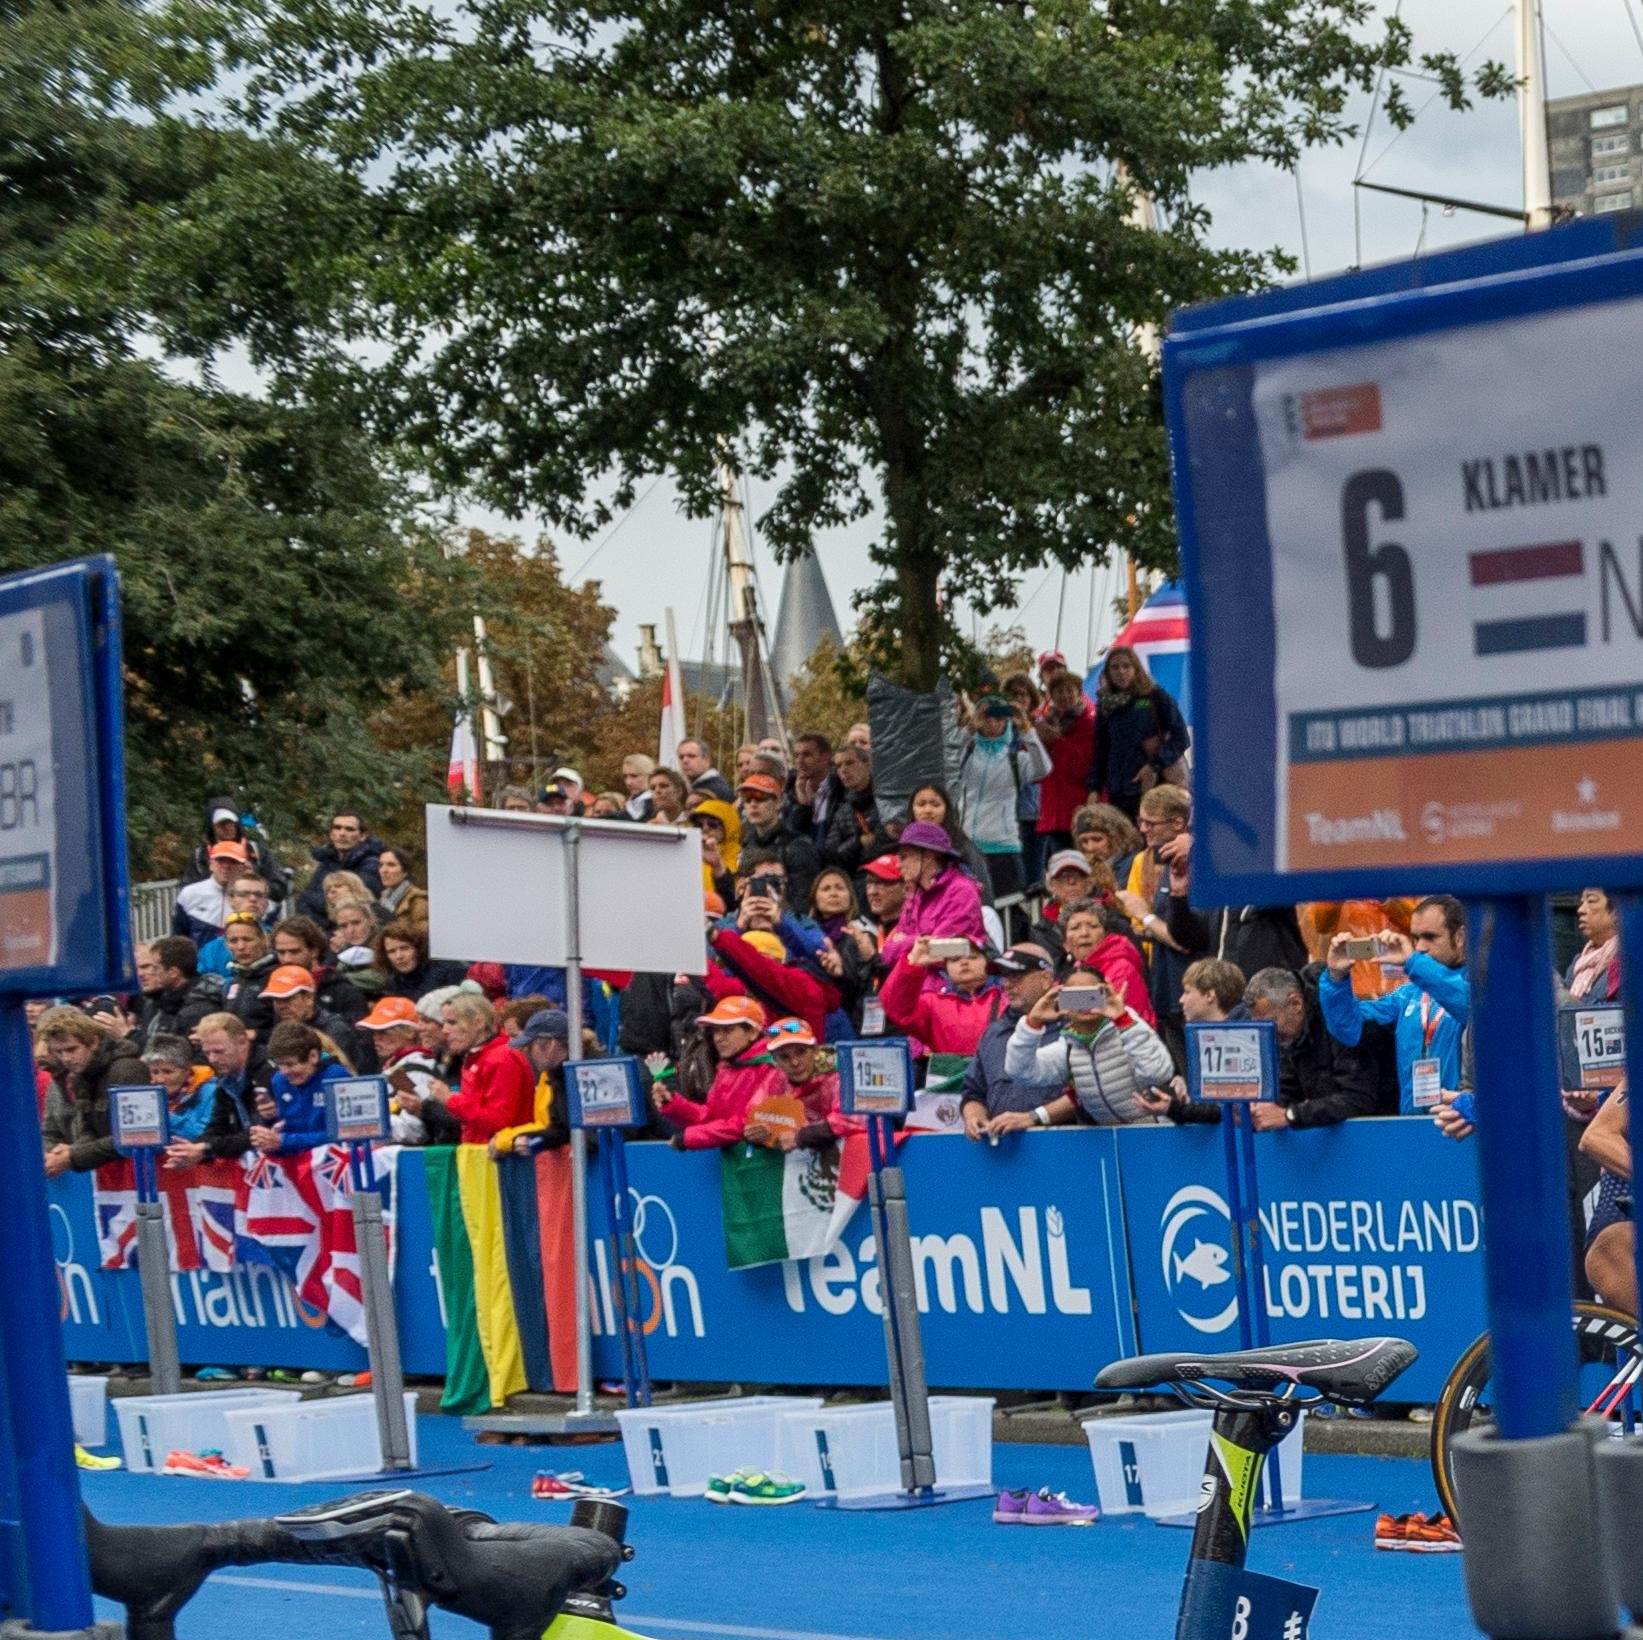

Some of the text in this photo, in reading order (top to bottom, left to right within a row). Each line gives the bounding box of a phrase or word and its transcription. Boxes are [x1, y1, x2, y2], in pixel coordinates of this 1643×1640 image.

[1461, 444, 1608, 514] KLAMER
[1341, 467, 1417, 670] 6
[1339, 714, 1402, 751] WORLD
[1409, 707, 1503, 747] TRIATHLON
[1508, 701, 1573, 738] GRAND
[1577, 696, 1632, 731] FINAL
[1304, 810, 1407, 846] TeamNL
[1203, 1046, 1223, 1073] 17
[1581, 1028, 1604, 1058] 15
[857, 1061, 872, 1087] 19
[1264, 1264, 1426, 1320] LOTERIJ
